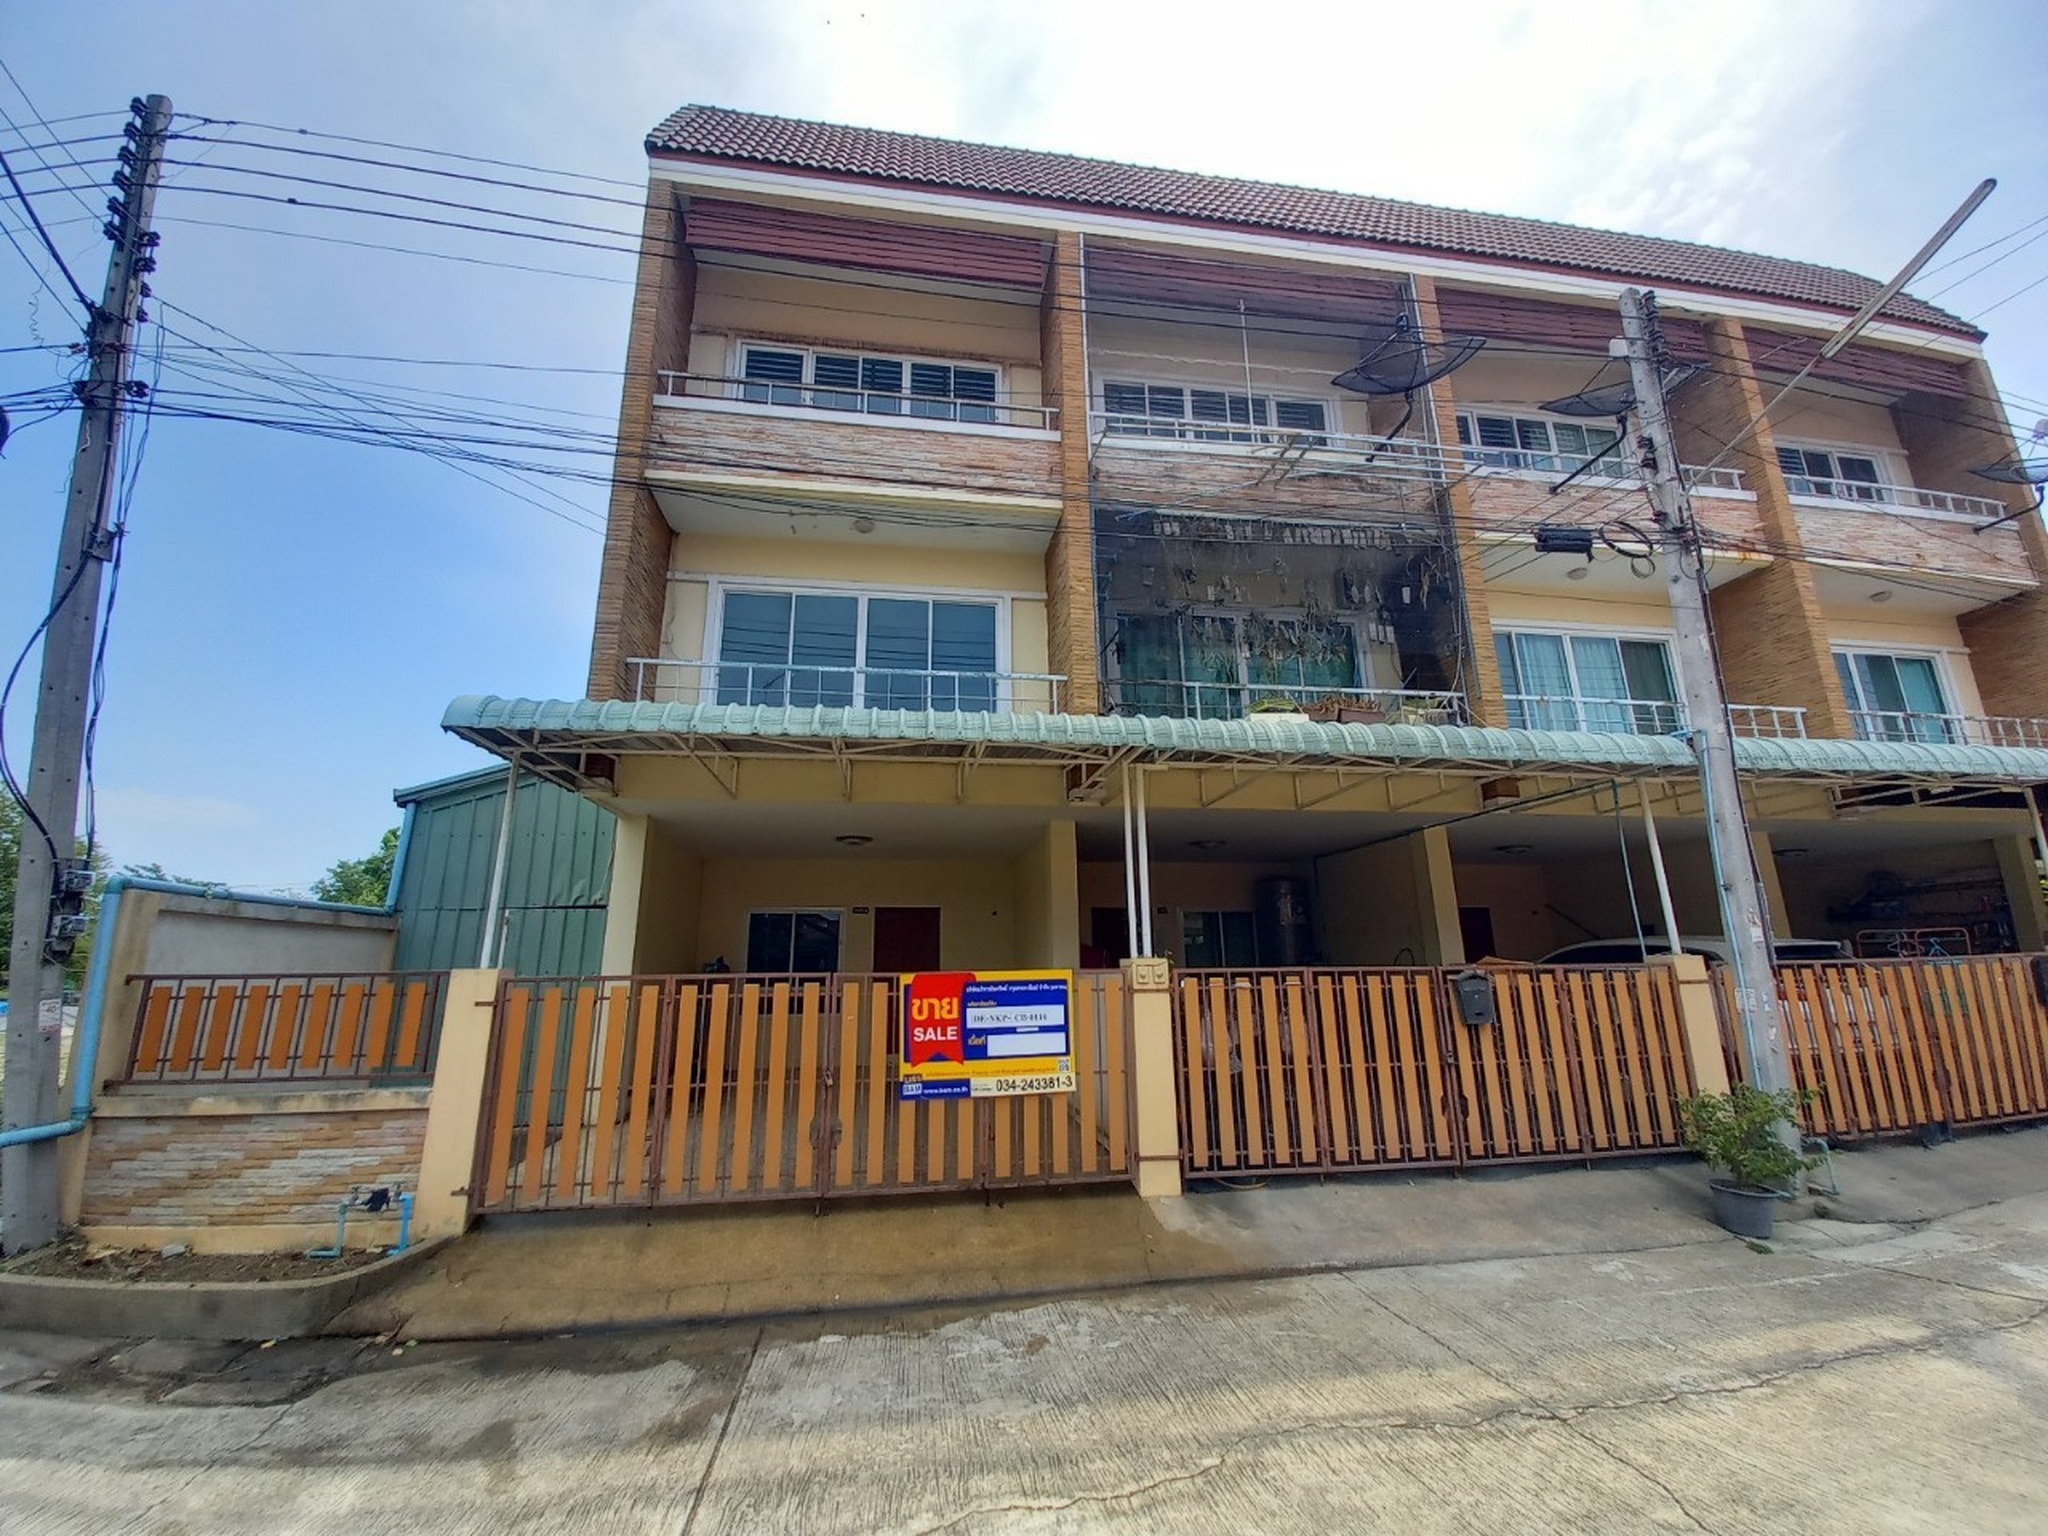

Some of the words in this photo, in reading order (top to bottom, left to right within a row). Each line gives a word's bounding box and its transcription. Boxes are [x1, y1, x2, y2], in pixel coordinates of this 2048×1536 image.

[911, 997, 959, 1021] ขาย
[913, 1026, 958, 1042] SALE
[996, 1074, 1073, 1093] 034-243381-3
